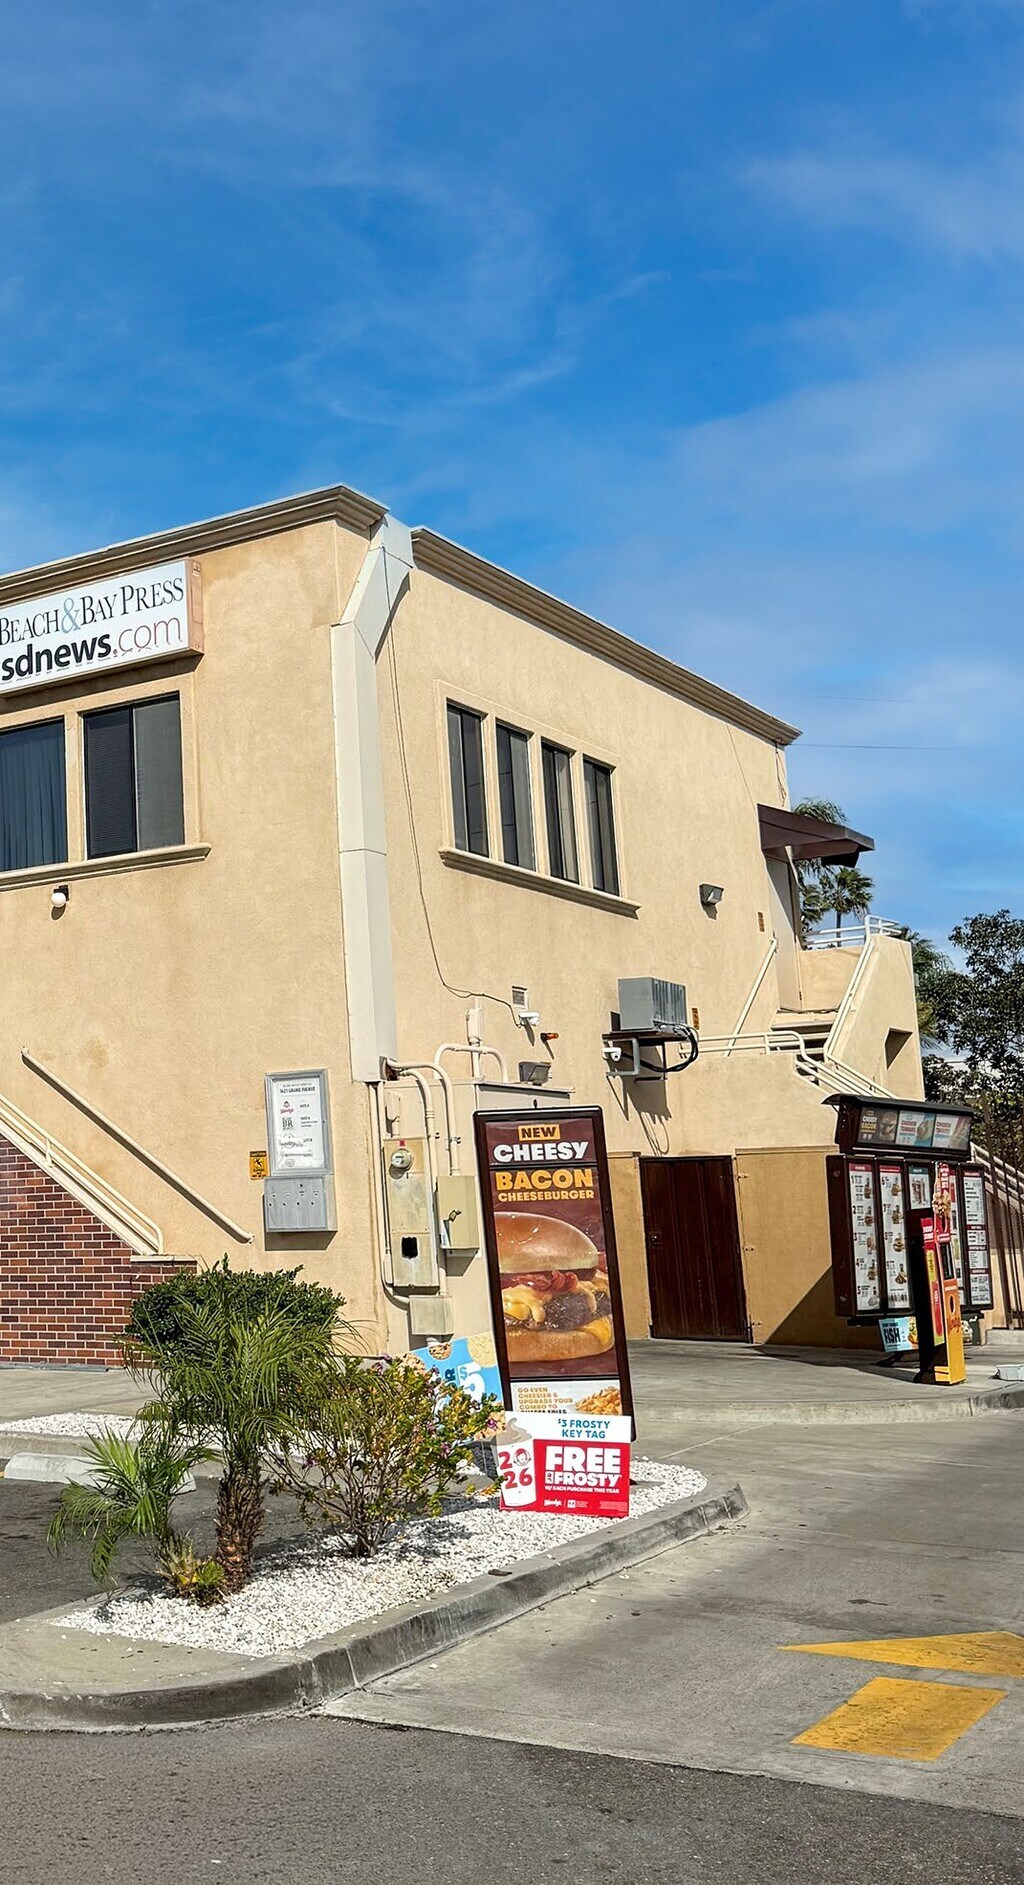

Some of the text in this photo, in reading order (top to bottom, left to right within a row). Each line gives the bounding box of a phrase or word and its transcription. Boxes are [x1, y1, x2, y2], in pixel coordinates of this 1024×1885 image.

[120, 577, 184, 615] PRESS
[1, 617, 183, 681] sdnews.com
[521, 1127, 556, 1138] NEW
[493, 1142, 588, 1162] CHEESY
[495, 1168, 594, 1190] BACON
[498, 1190, 594, 1202] CHEESEBURGER
[558, 1418, 610, 1429] $3 FROSTY
[562, 1429, 606, 1438] KEY TAG
[545, 1445, 621, 1474] FREE
[504, 1467, 533, 1489] 26
[555, 1471, 621, 1487] FROSTY
